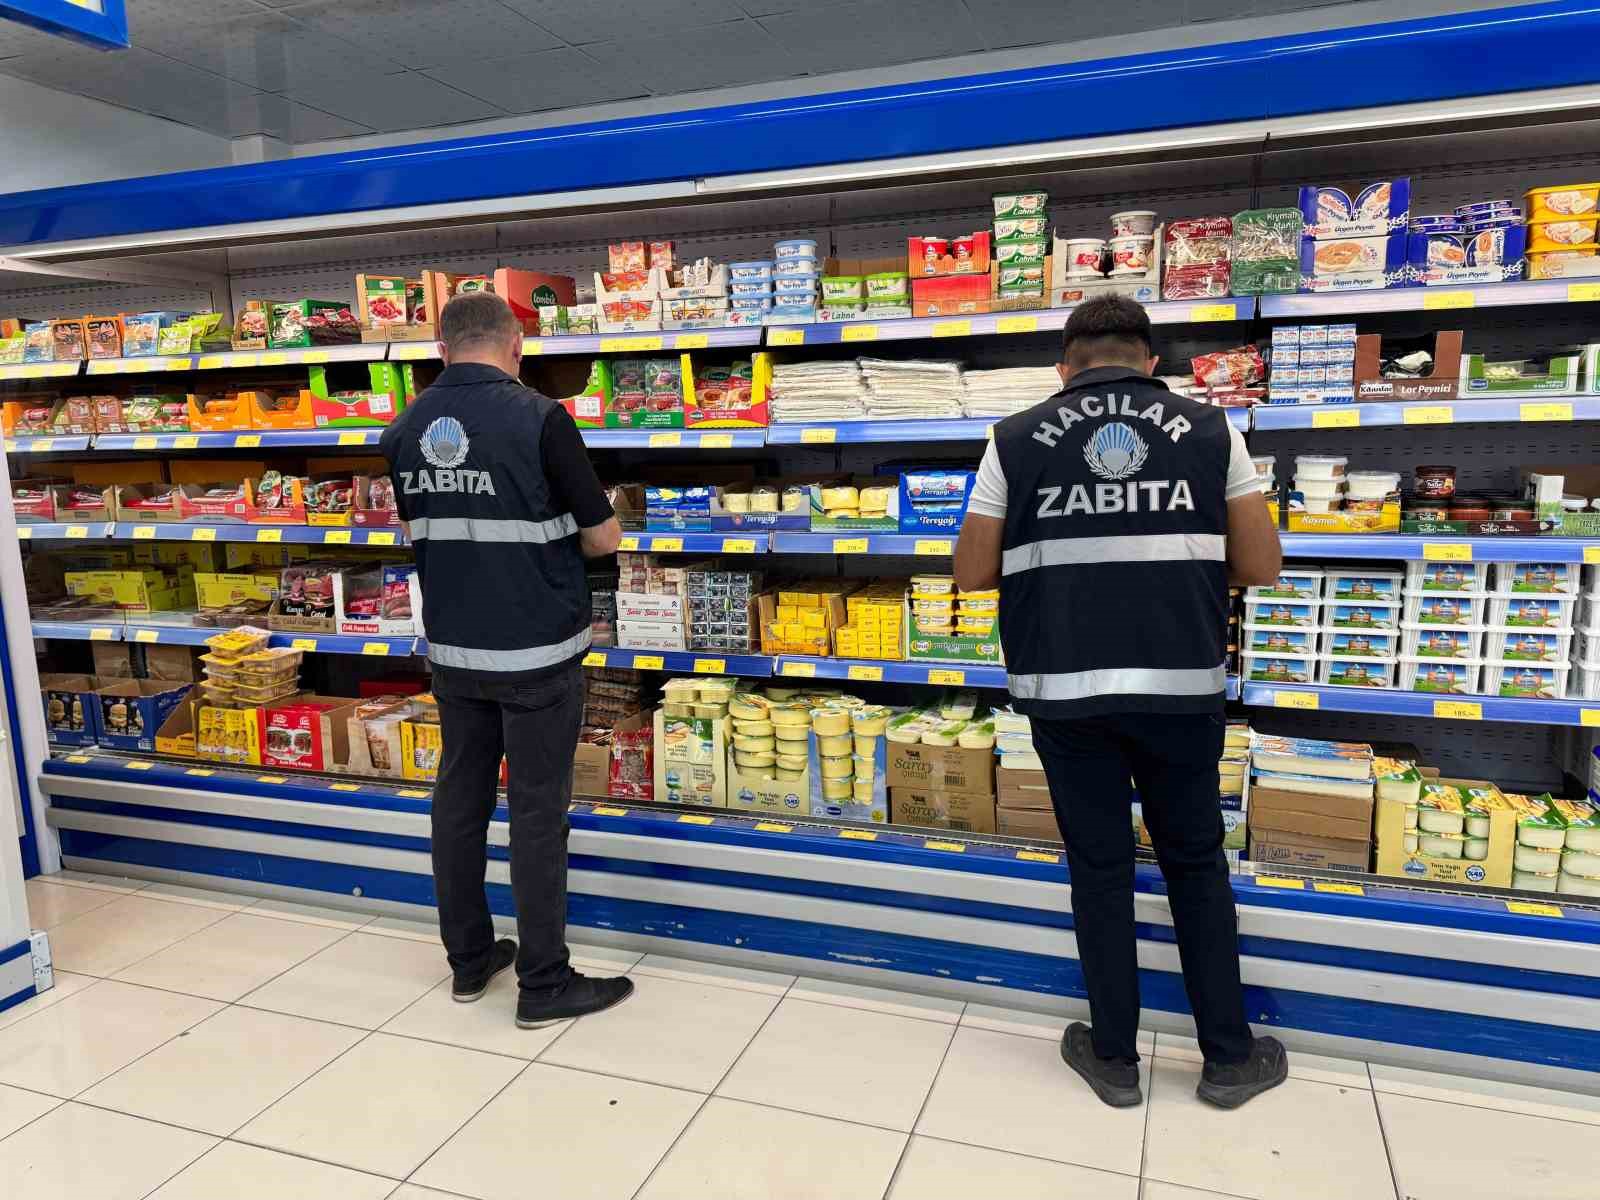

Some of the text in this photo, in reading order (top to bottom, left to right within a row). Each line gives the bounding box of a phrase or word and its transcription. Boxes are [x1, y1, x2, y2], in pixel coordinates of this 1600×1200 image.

[831, 312, 856, 321] Labne
[1401, 385, 1417, 393] Lor
[1032, 393, 1192, 448] HACILAR
[399, 469, 497, 496] ZABITA
[1036, 480, 1196, 519] ZABITA
[920, 515, 957, 527] Tereyağı
